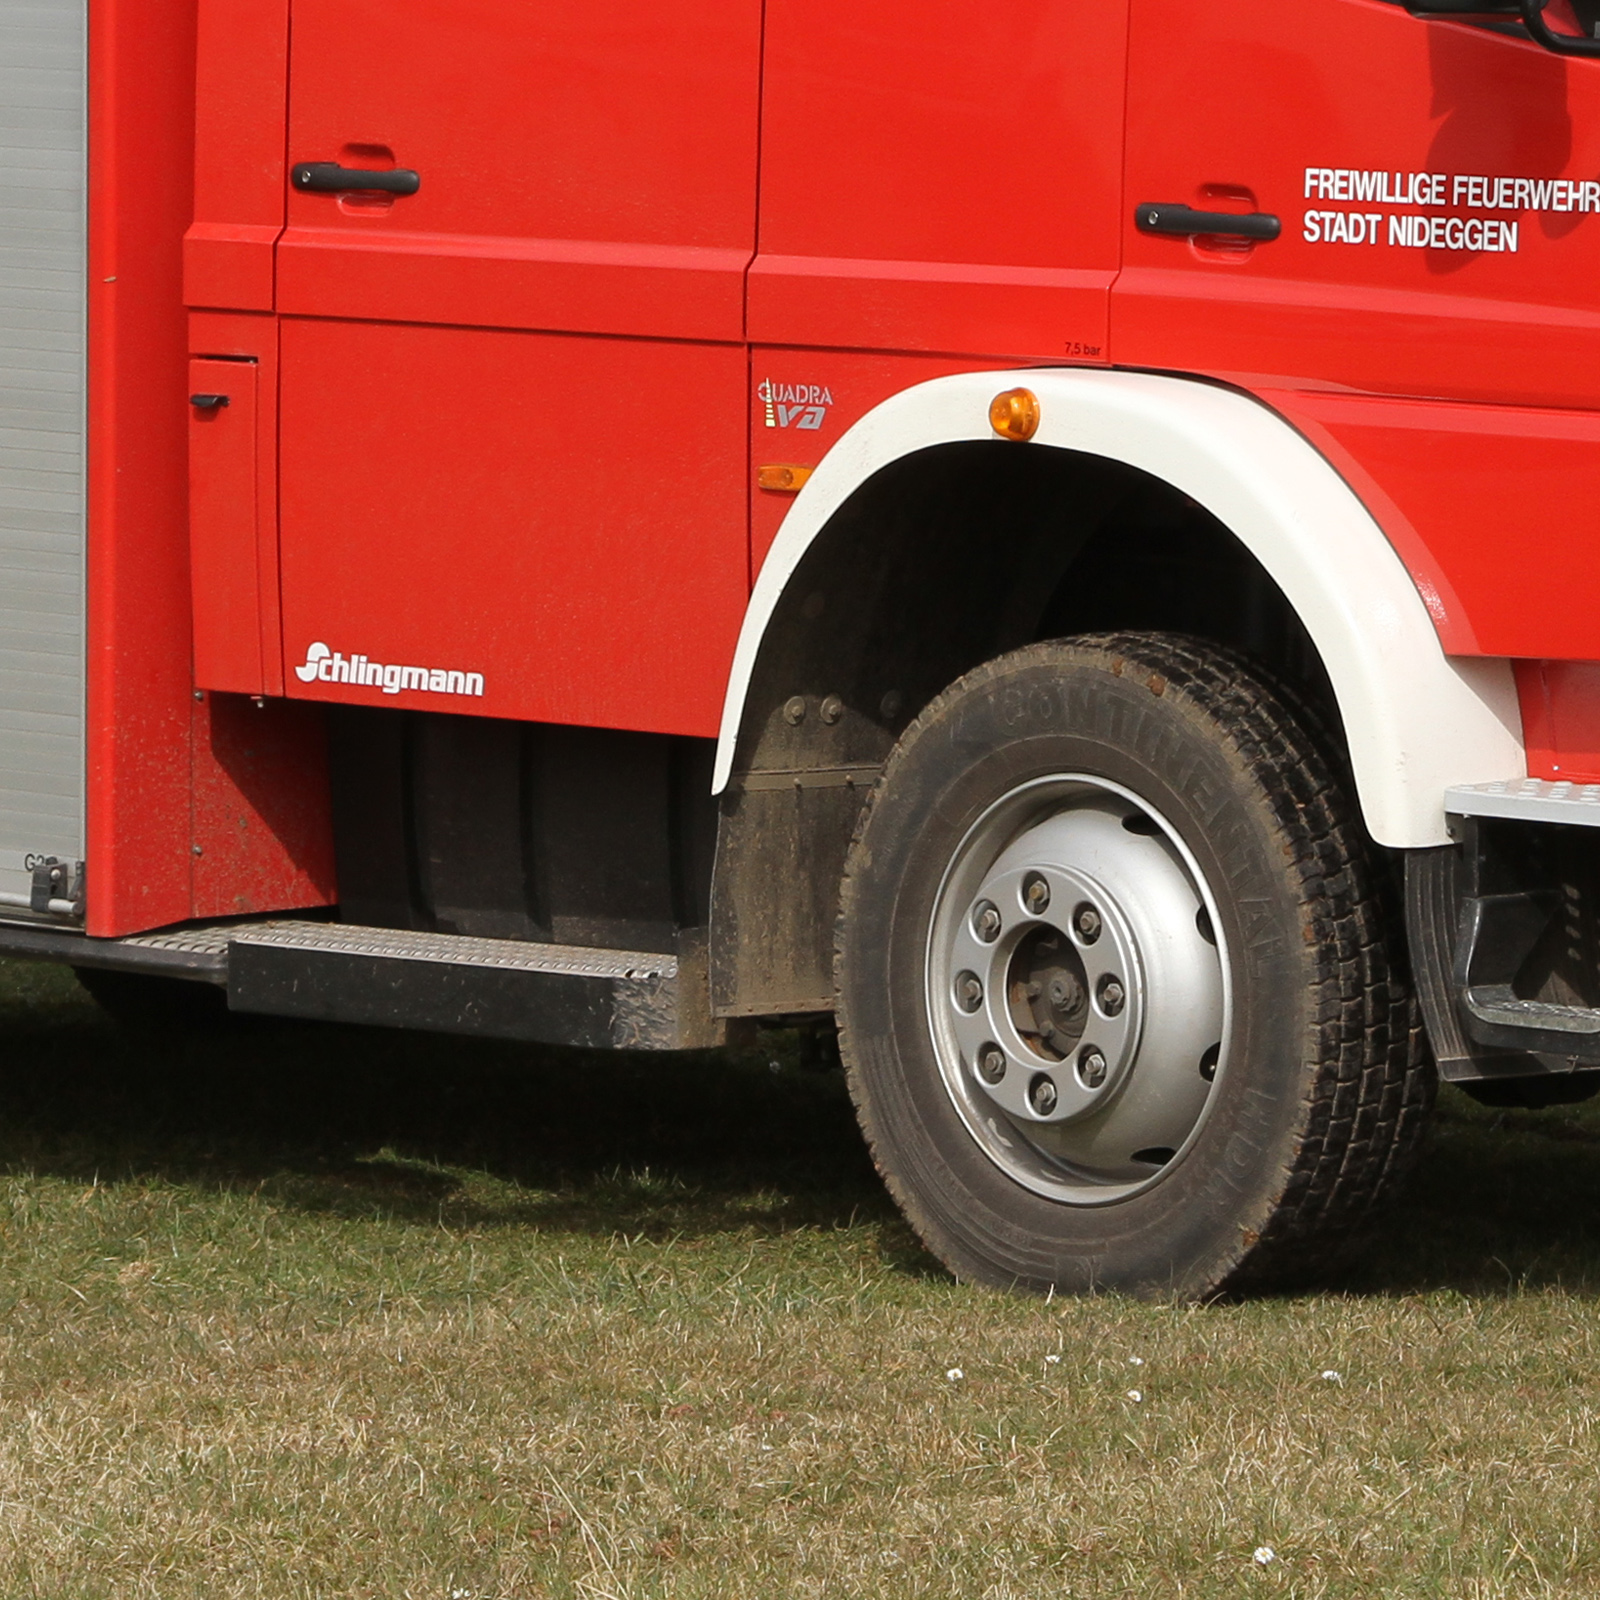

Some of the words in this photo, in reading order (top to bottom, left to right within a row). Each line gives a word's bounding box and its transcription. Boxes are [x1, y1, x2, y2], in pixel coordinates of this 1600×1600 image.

[1304, 168, 1446, 205] FREIWILLIGE
[1452, 175, 1600, 213] FEUERWEHR
[1303, 209, 1381, 244] STADT
[1388, 214, 1518, 252] NIDEGGEN
[1083, 343, 1101, 356] bar
[757, 380, 833, 406] QUADRA
[295, 641, 485, 697] Schlingmann
